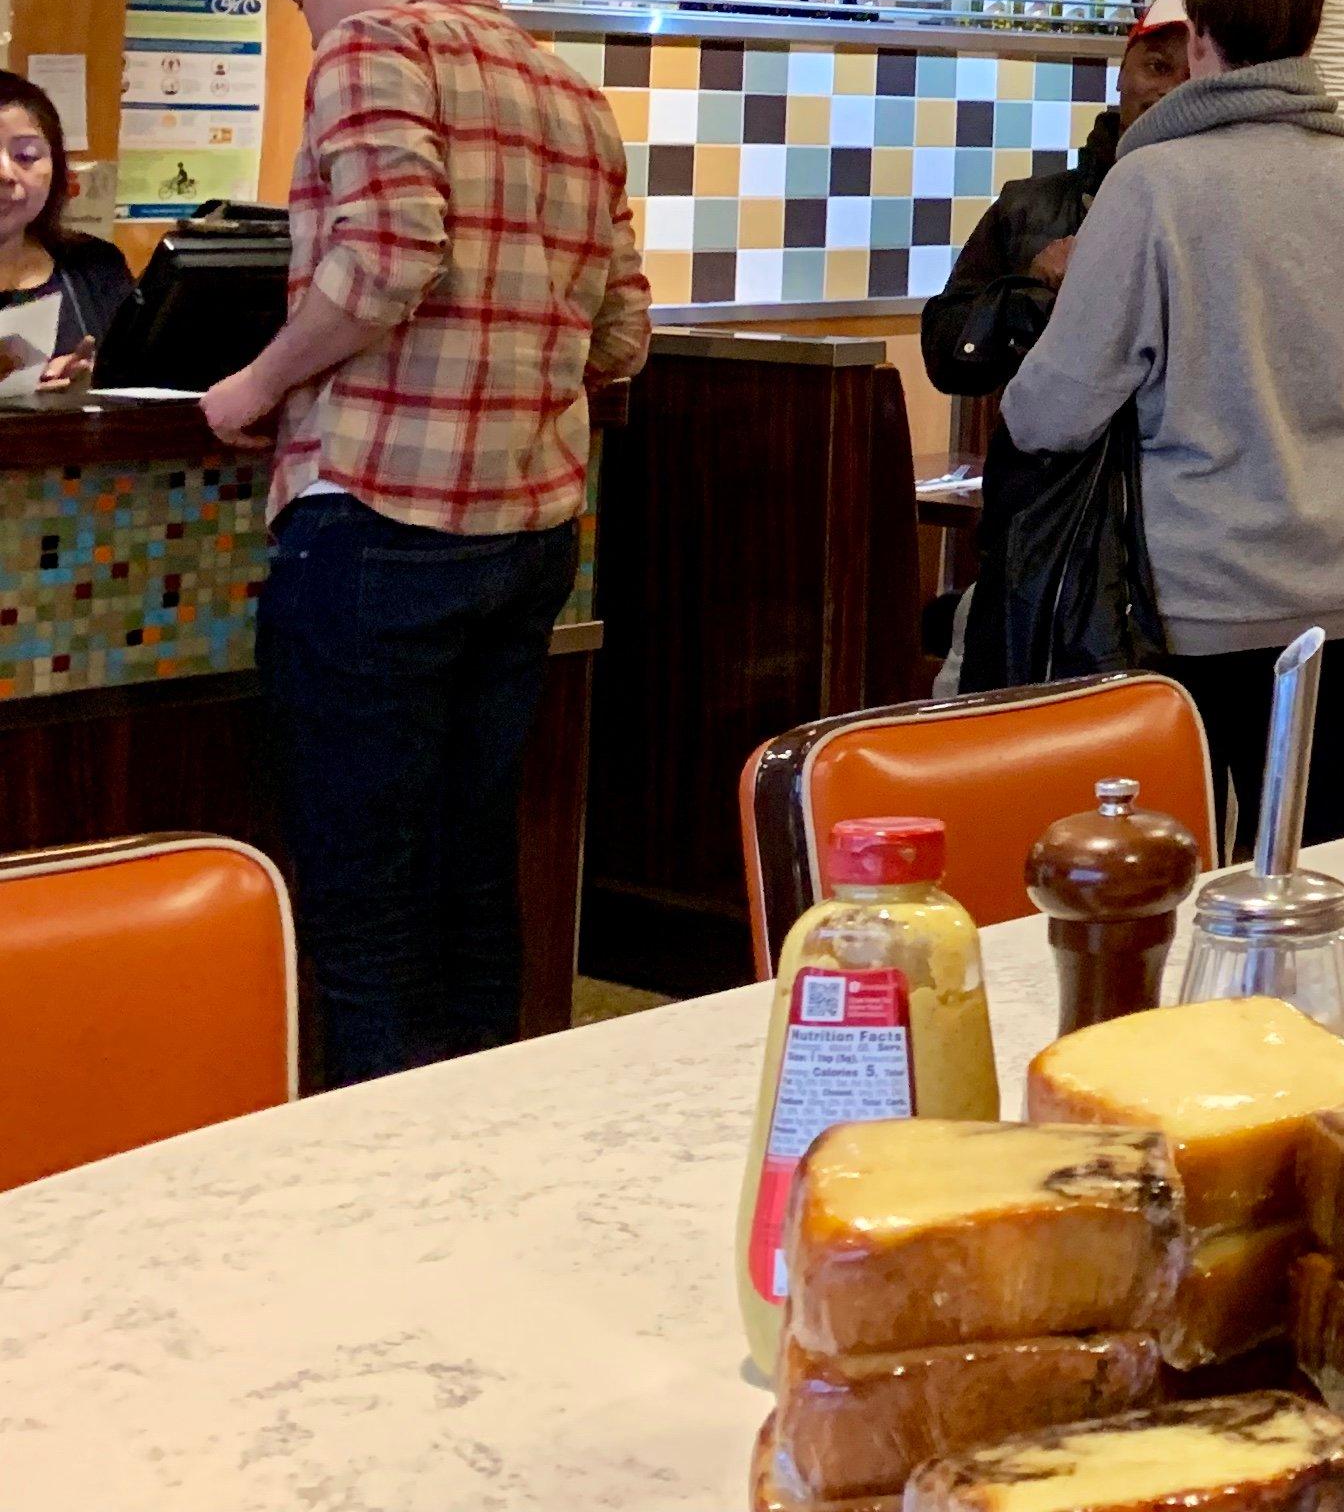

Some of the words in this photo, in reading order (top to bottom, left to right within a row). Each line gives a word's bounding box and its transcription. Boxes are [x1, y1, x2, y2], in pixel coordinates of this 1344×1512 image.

[791, 1030, 854, 1042] Nutrition
[859, 1030, 902, 1042] Facts
[812, 1066, 859, 1078] Calories
